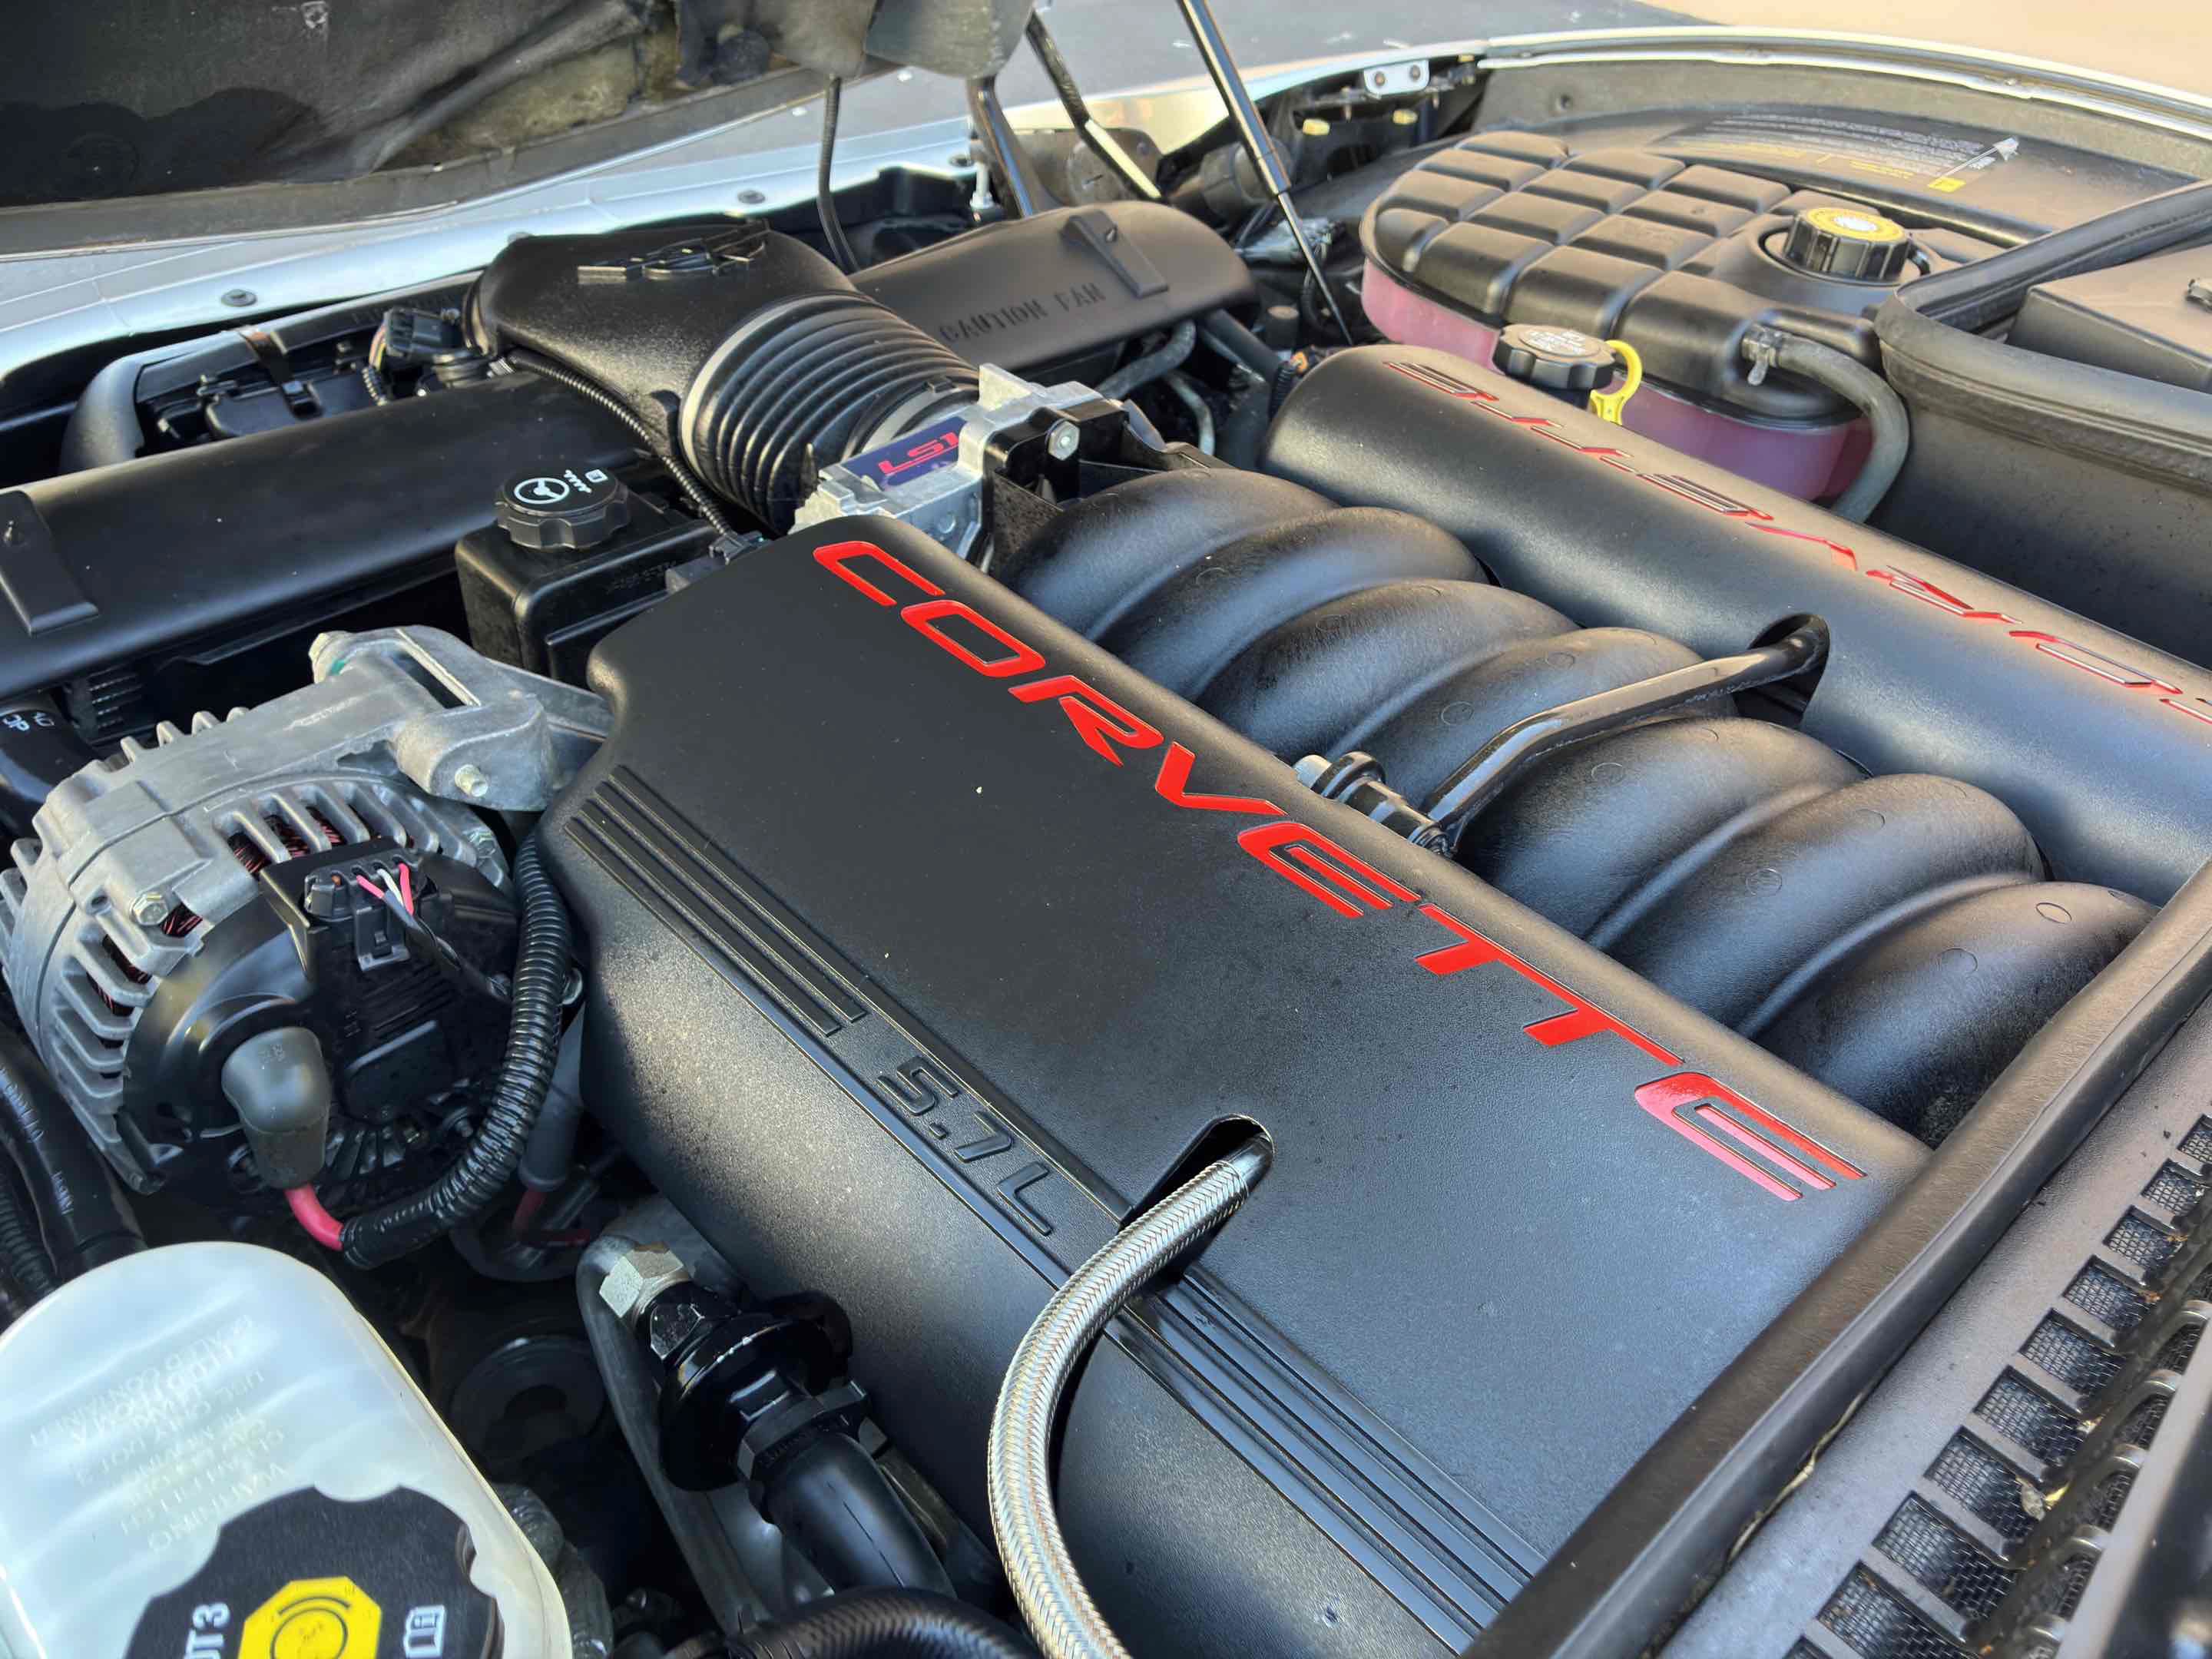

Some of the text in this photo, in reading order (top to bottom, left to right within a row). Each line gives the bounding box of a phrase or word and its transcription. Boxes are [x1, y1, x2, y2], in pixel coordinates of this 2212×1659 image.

[938, 281, 1108, 343] CAUTION FAN
[878, 432, 961, 475] LS1
[813, 540, 1867, 1201] CORVETTE
[873, 1056, 1054, 1236] 5.7L
